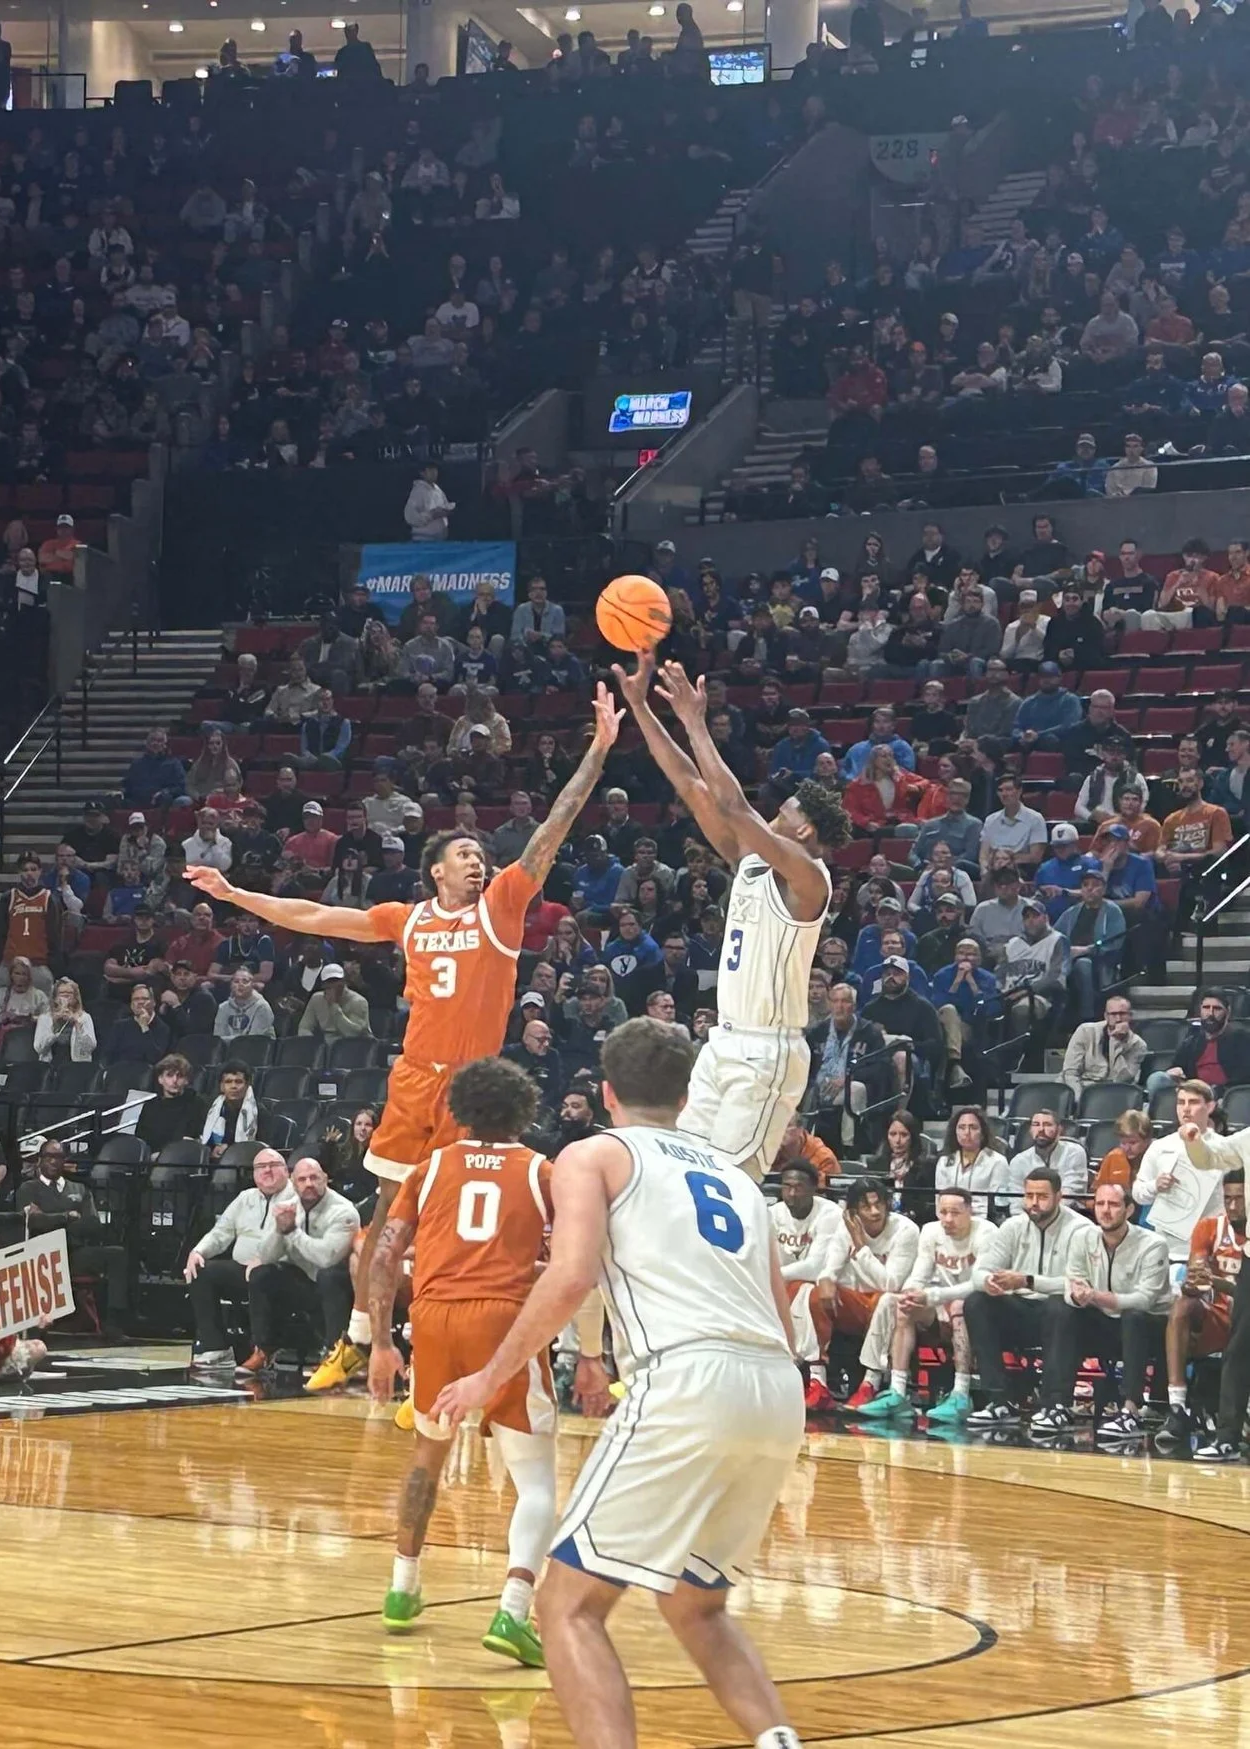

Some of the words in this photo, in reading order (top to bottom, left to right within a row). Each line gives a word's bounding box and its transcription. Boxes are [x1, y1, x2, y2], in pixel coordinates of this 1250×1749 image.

[366, 572, 511, 593] #MARMADNESS
[413, 929, 480, 953] TEXAS
[727, 929, 744, 972] 3
[430, 957, 457, 998] 3
[464, 1153, 506, 1171] POPE
[456, 1180, 502, 1241] 0
[684, 1170, 744, 1254] 6
